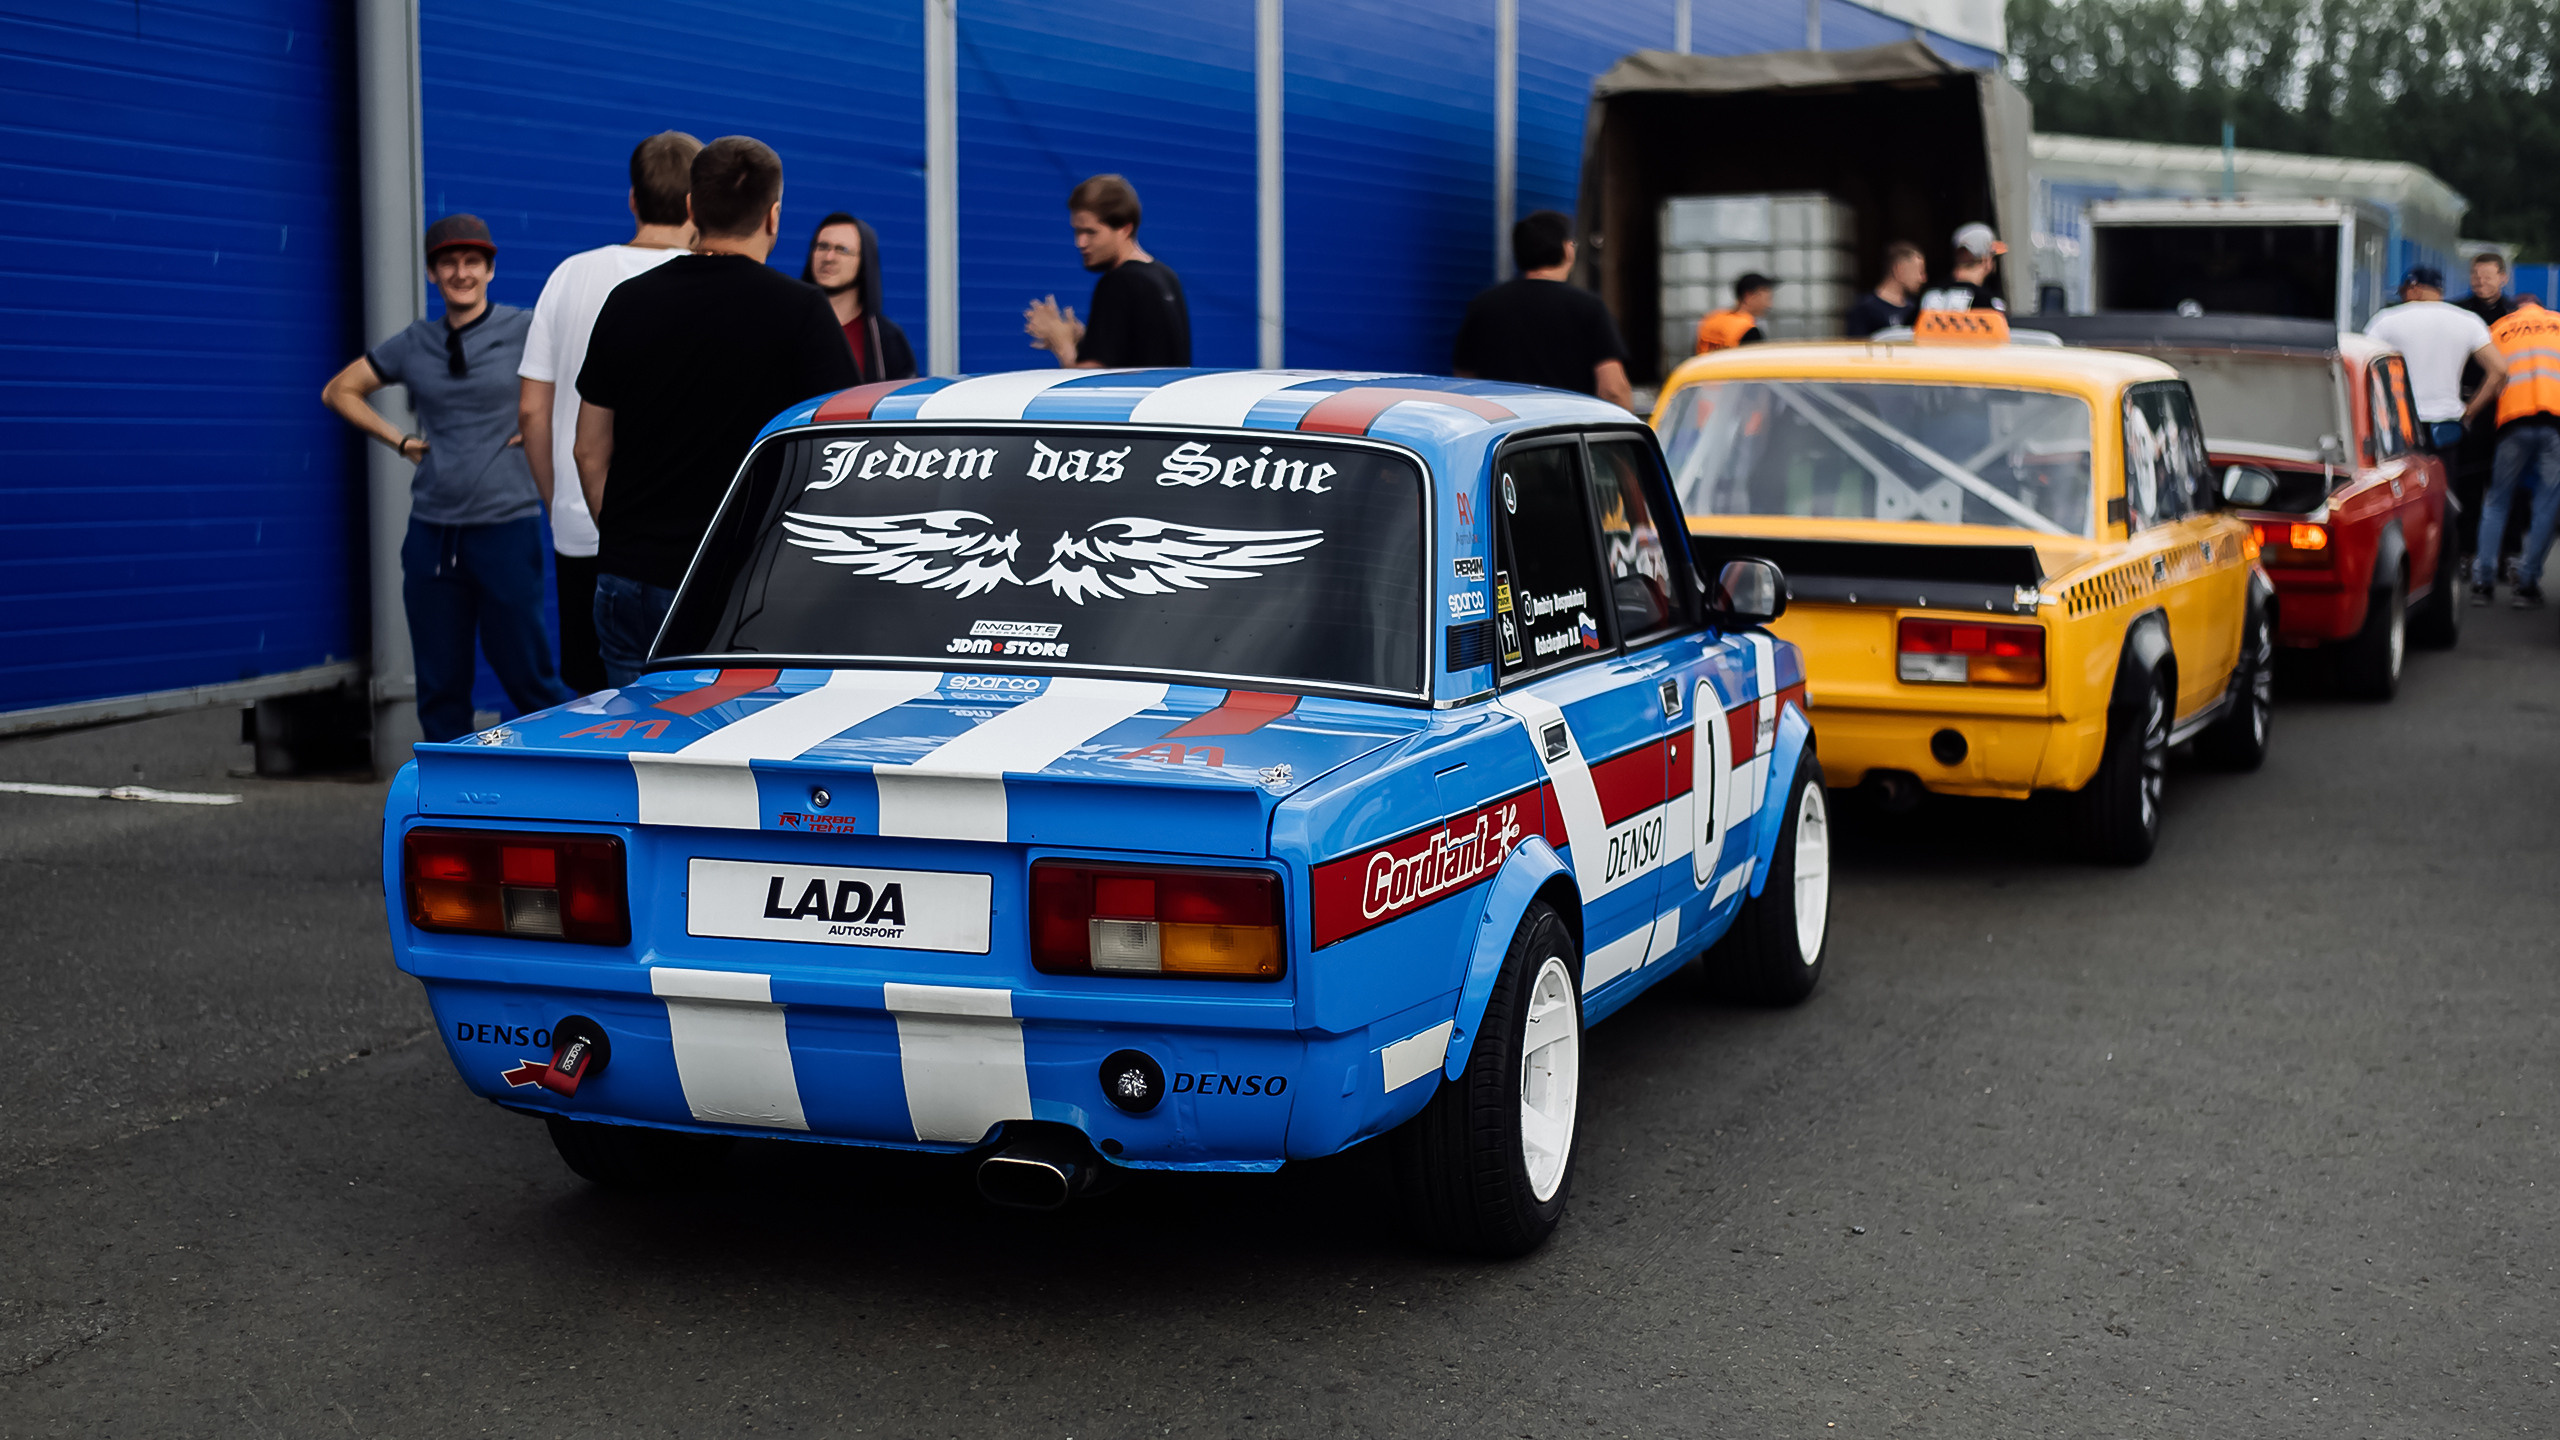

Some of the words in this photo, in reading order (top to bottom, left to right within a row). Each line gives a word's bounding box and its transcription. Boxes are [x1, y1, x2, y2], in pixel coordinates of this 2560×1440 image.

[804, 438, 999, 492] Jedem
[1027, 438, 1132, 483] das
[1156, 440, 1337, 495] Seine
[1448, 590, 1485, 619] sparco
[976, 622, 1059, 634] INNOVATE
[946, 637, 993, 654] JDM
[948, 675, 1041, 691] sparco
[1705, 719, 1716, 845] 1
[801, 814, 857, 826] TURBO
[1604, 816, 1663, 885] DENSO
[1363, 814, 1489, 920] Cordiant
[763, 876, 906, 926] LADA
[828, 925, 905, 939] AUTOSPORT
[456, 1022, 551, 1049] DENSO
[1171, 1072, 1288, 1097] DENSO
